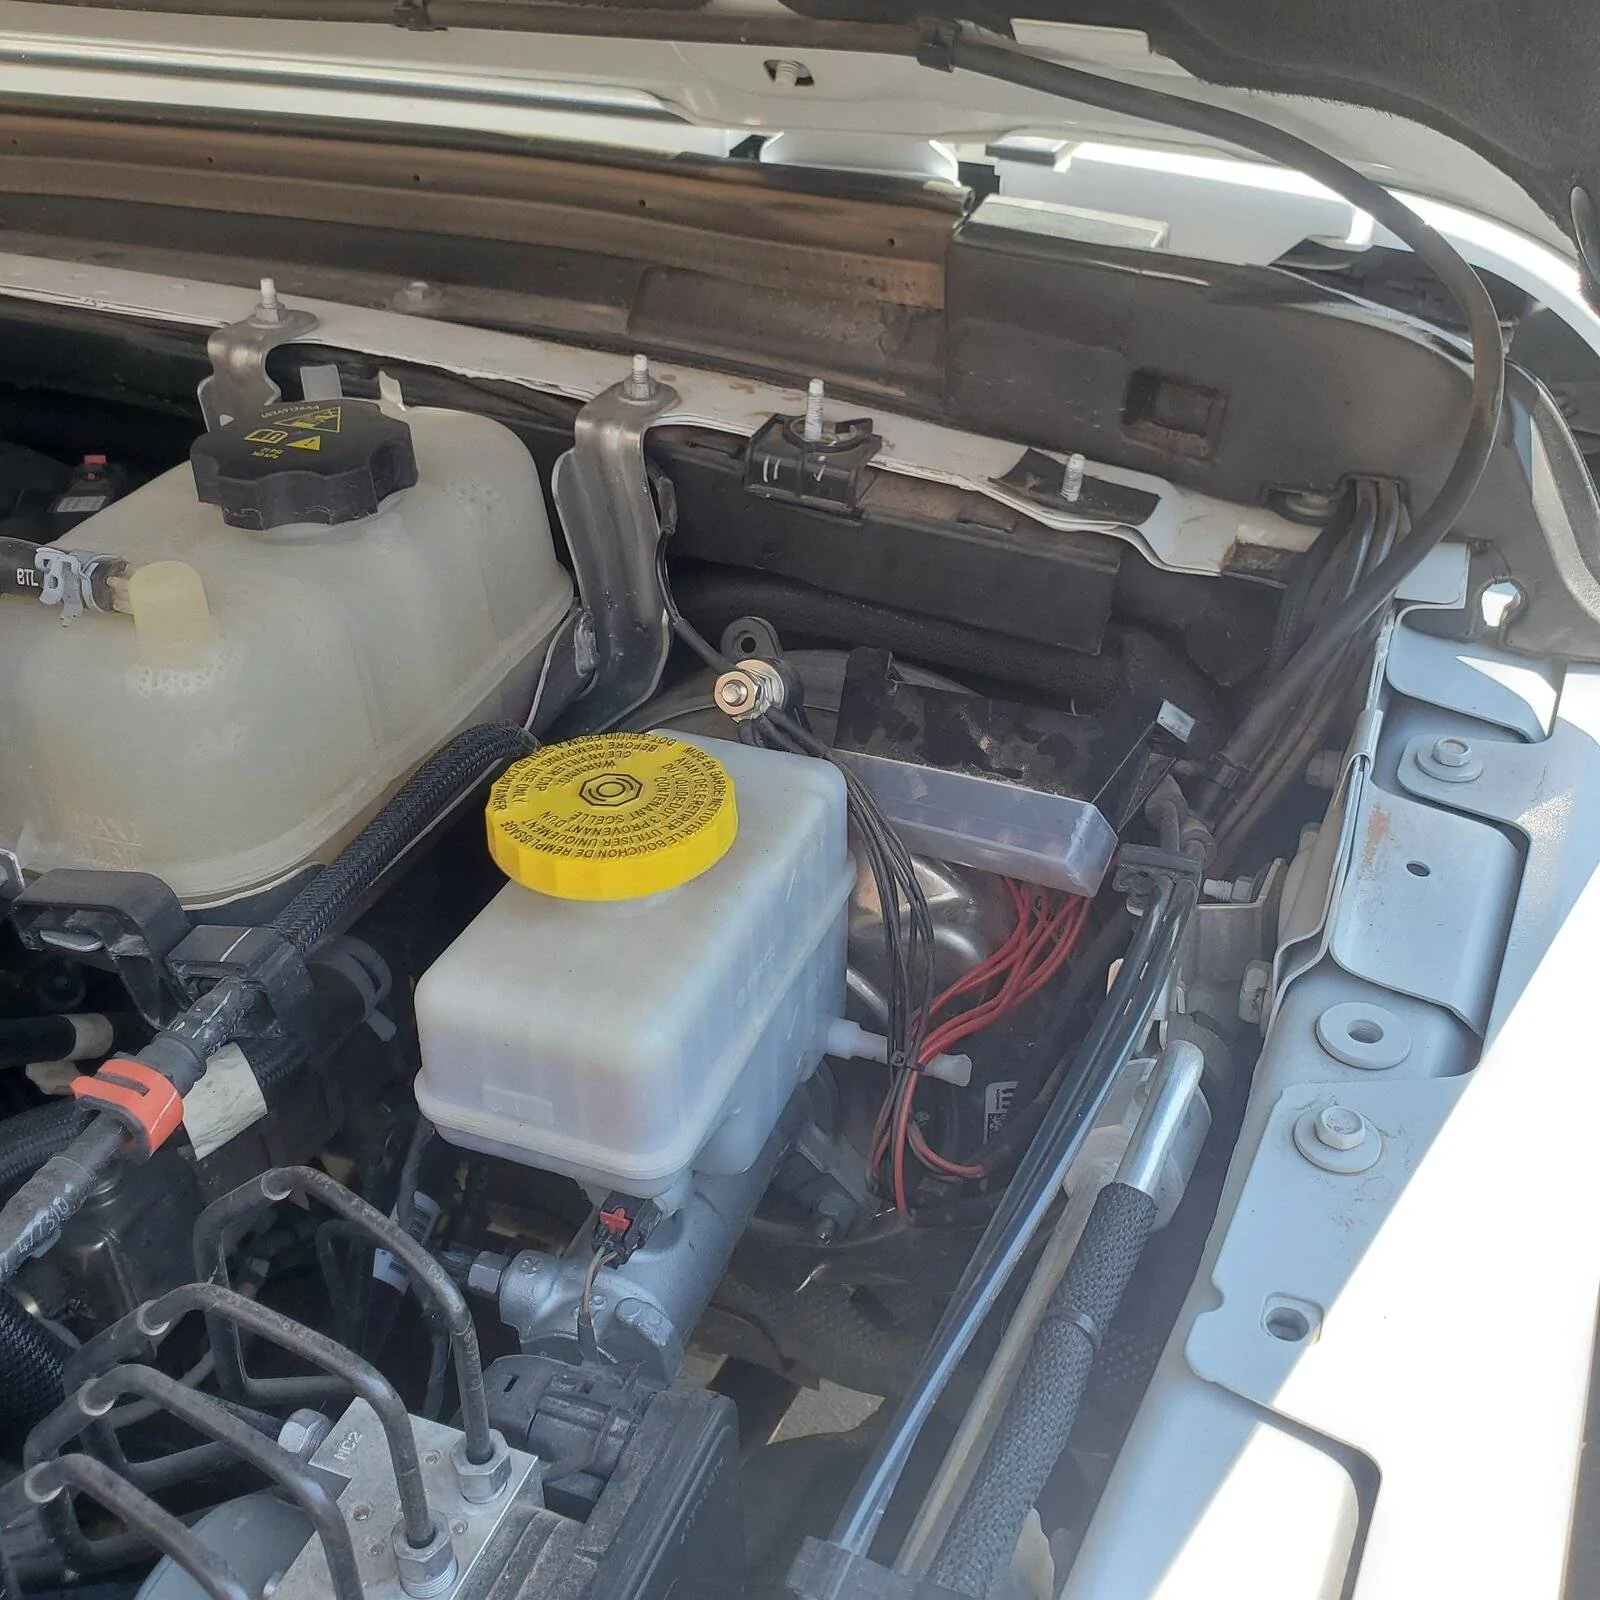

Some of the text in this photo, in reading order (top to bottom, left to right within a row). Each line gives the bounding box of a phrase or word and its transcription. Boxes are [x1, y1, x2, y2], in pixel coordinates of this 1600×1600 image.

[17, 568, 39, 587] BTL
[567, 735, 601, 746] FROM
[606, 732, 639, 740] FLUID
[652, 735, 676, 747] DOT
[608, 741, 658, 752] BEFORE
[683, 747, 708, 761] MISE
[515, 747, 554, 770] SEALED
[675, 757, 705, 777] AVANT
[703, 760, 718, 771] EN
[520, 767, 543, 783] USE
[535, 750, 632, 792] CLEAN FILLER CAP
[493, 769, 520, 811] CONTAINER
[694, 778, 708, 789] DE
[513, 783, 529, 803] ONLY
[540, 763, 689, 836] DU LIQUIDE DOT 3 PROVENANT D'UN
[630, 776, 671, 820] CONTENANT
[694, 789, 707, 800] LE
[681, 798, 723, 835] NETTOYER
[500, 820, 573, 856] REMPLISSAGE
[522, 818, 598, 848] UNIQUEMENT
[603, 829, 663, 847] UTILISER
[665, 832, 684, 844] LE
[575, 849, 594, 858] DE
[599, 839, 667, 858] BOUCHON
